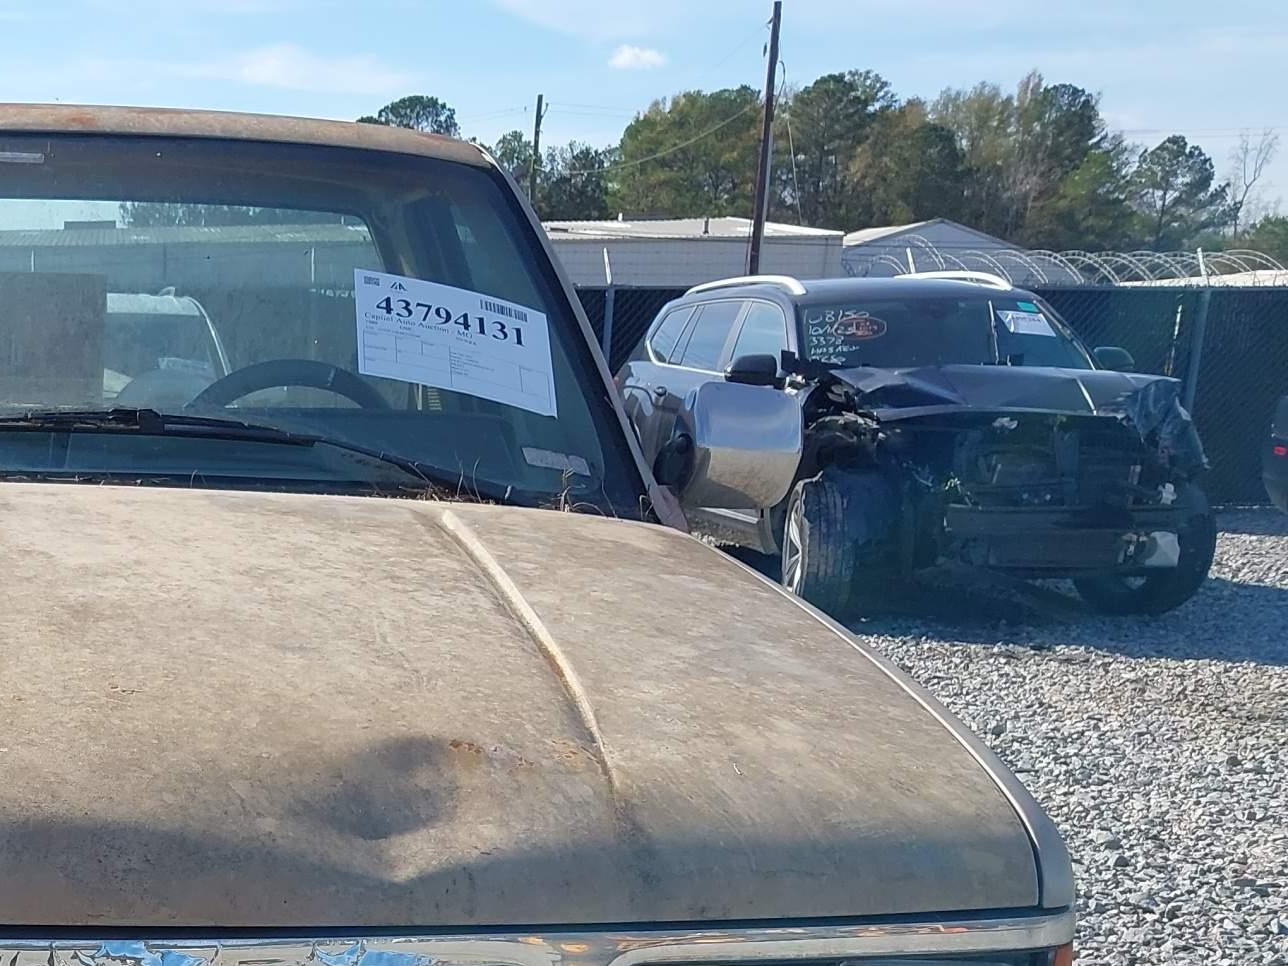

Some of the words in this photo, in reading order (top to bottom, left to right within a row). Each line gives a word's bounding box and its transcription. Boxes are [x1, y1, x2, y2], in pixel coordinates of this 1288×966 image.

[375, 295, 526, 347] 43794131
[396, 318, 416, 327] Auto
[417, 322, 450, 334] Auction
